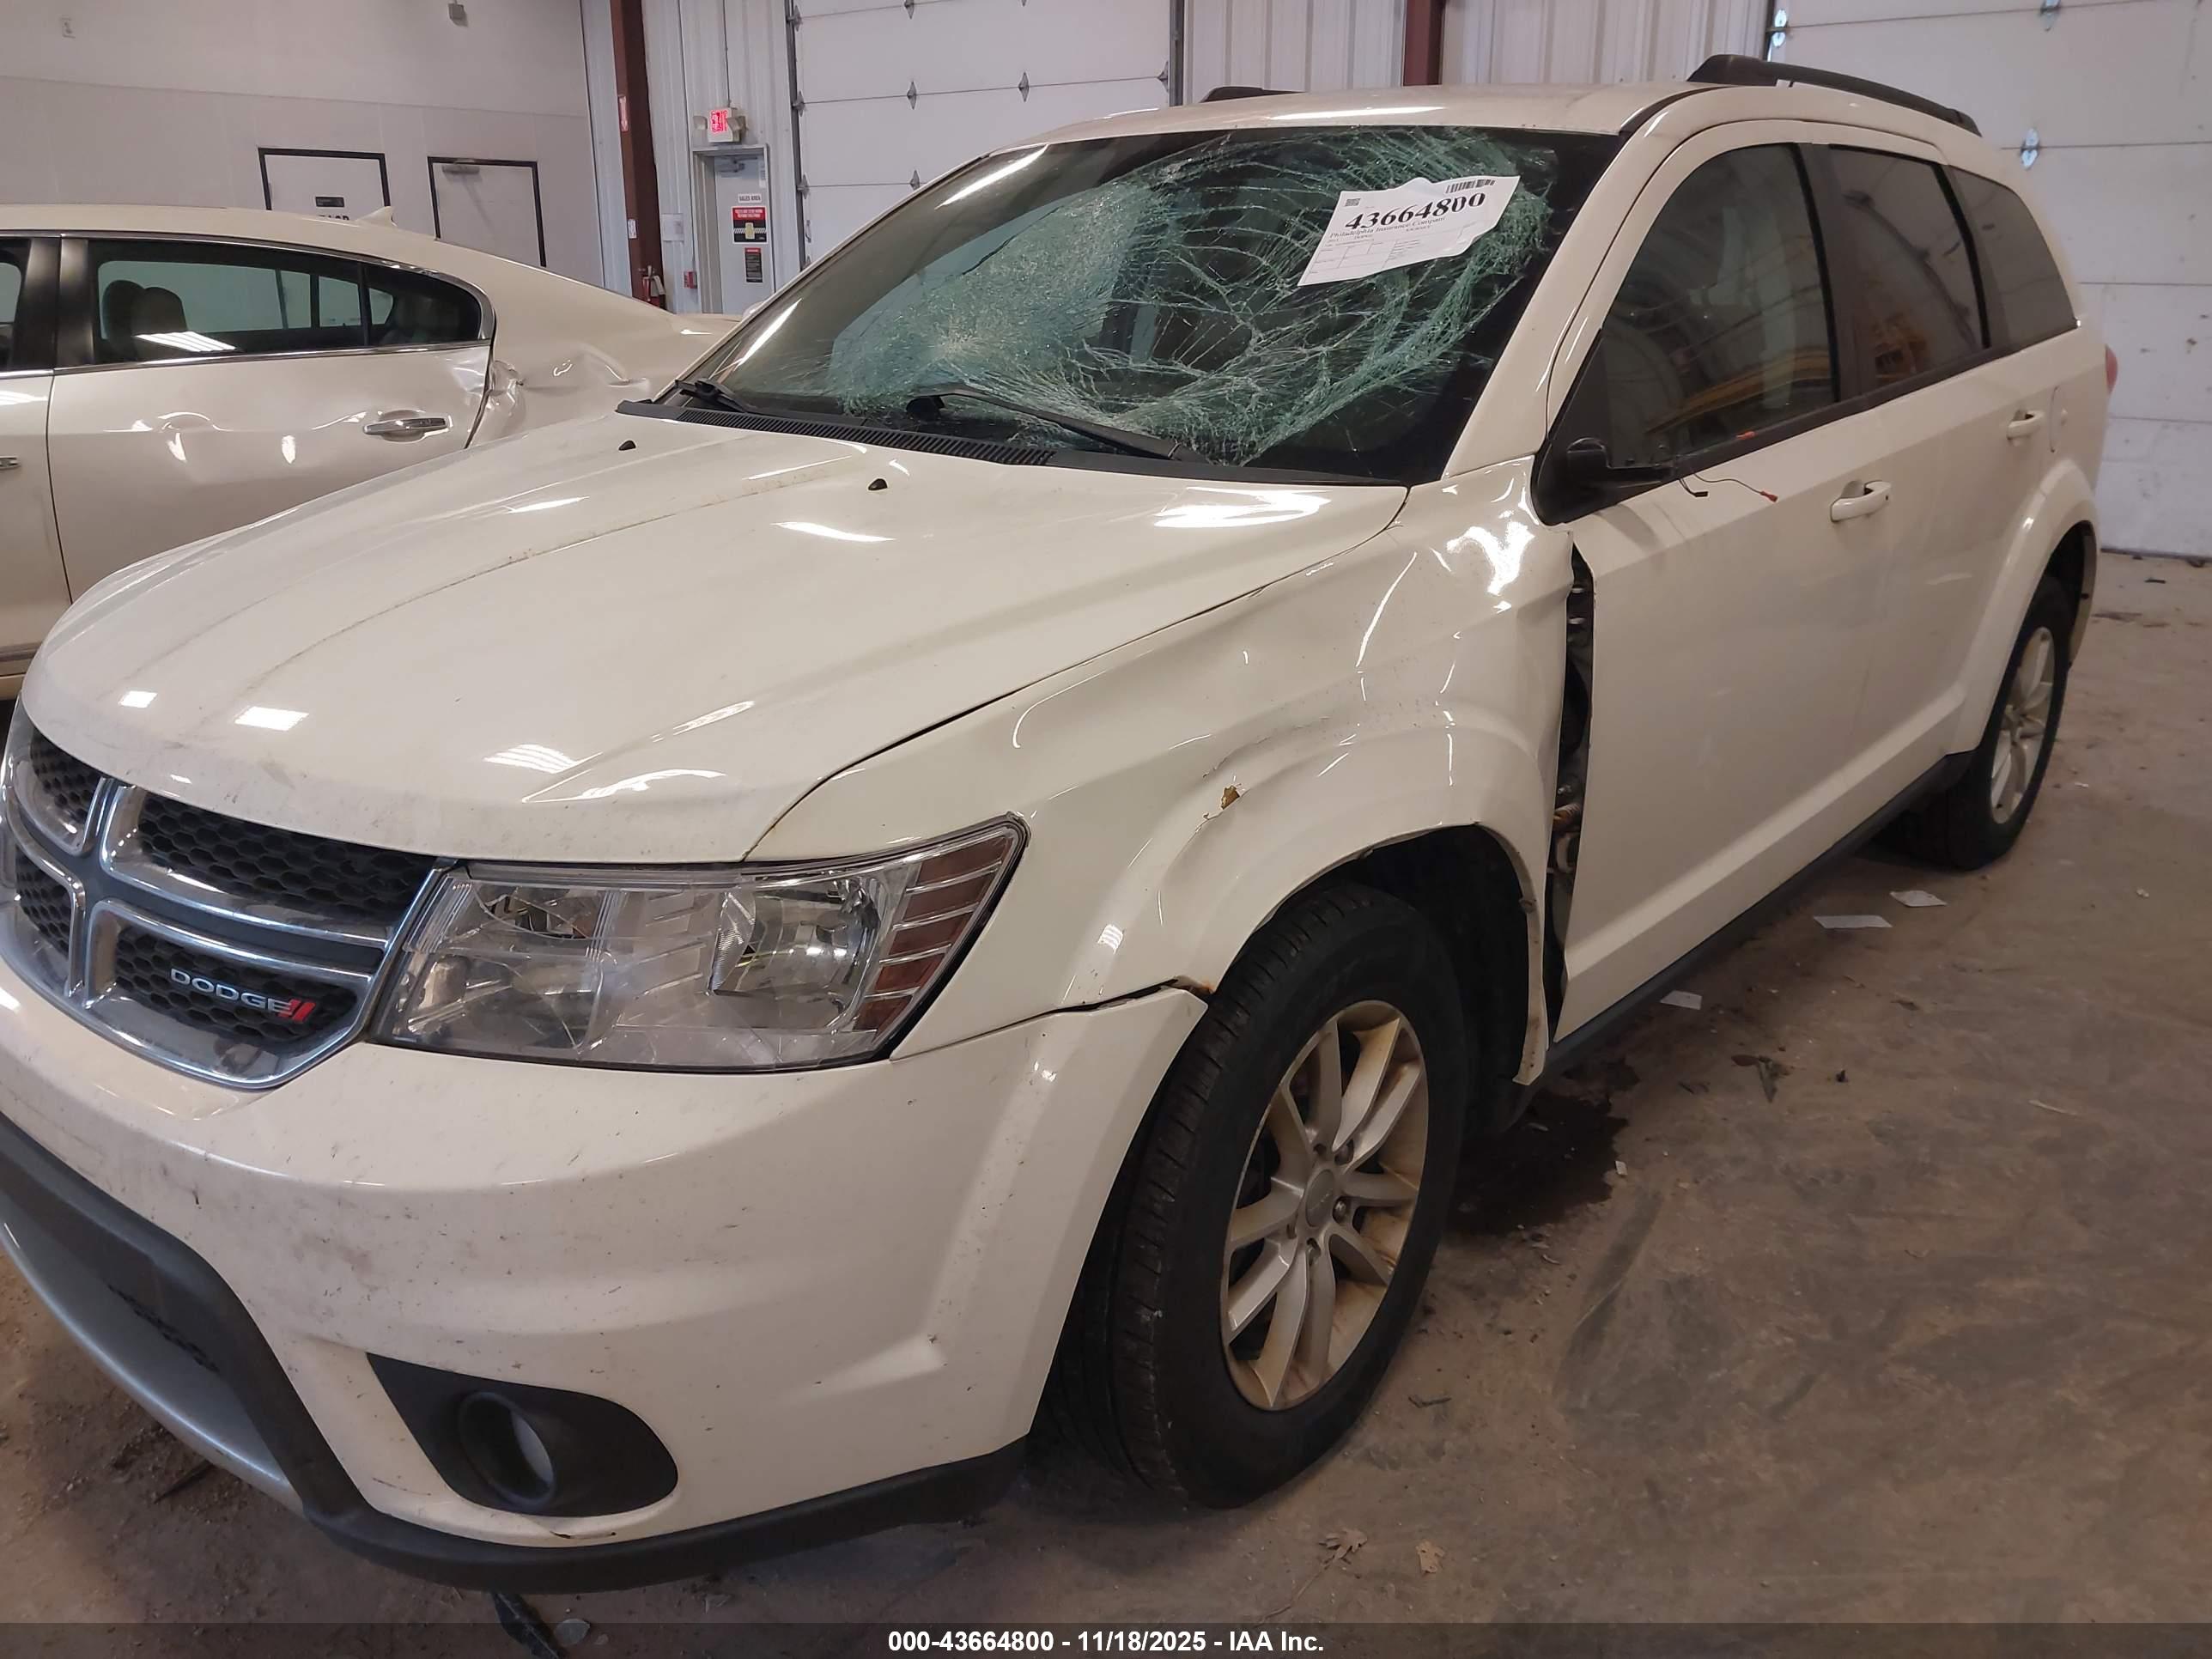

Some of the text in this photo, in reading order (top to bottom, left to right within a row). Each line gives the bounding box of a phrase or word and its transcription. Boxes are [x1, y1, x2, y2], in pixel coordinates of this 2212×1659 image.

[1345, 192, 1486, 229] 43664800
[1330, 228, 1374, 239] Philadelphia
[171, 968, 293, 1016] DODGE
